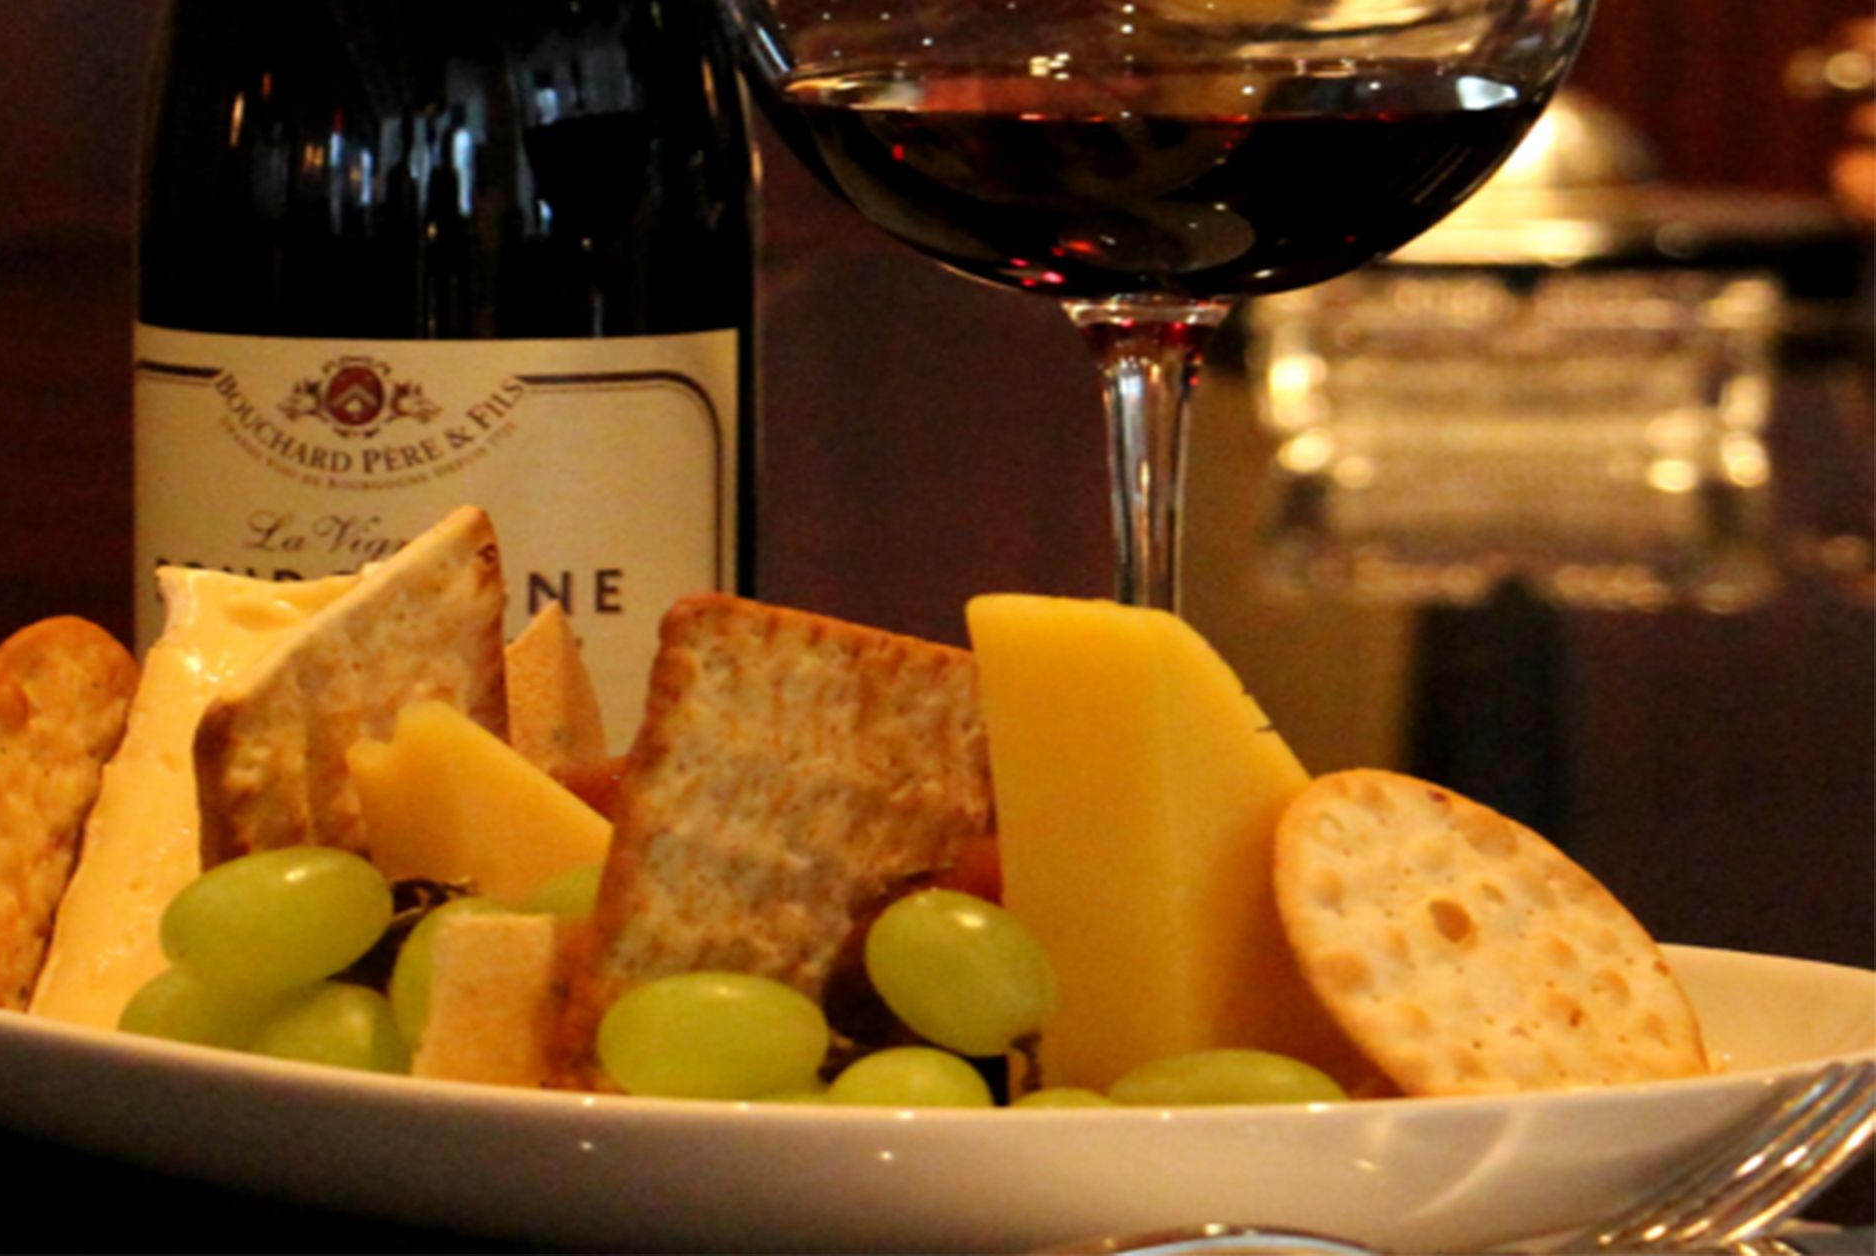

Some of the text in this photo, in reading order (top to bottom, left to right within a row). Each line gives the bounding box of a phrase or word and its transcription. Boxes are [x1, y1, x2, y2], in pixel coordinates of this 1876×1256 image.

[215, 372, 353, 473] BOUCHARD
[444, 426, 474, 448] &
[466, 377, 524, 431] FILS
[243, 508, 306, 552] La
